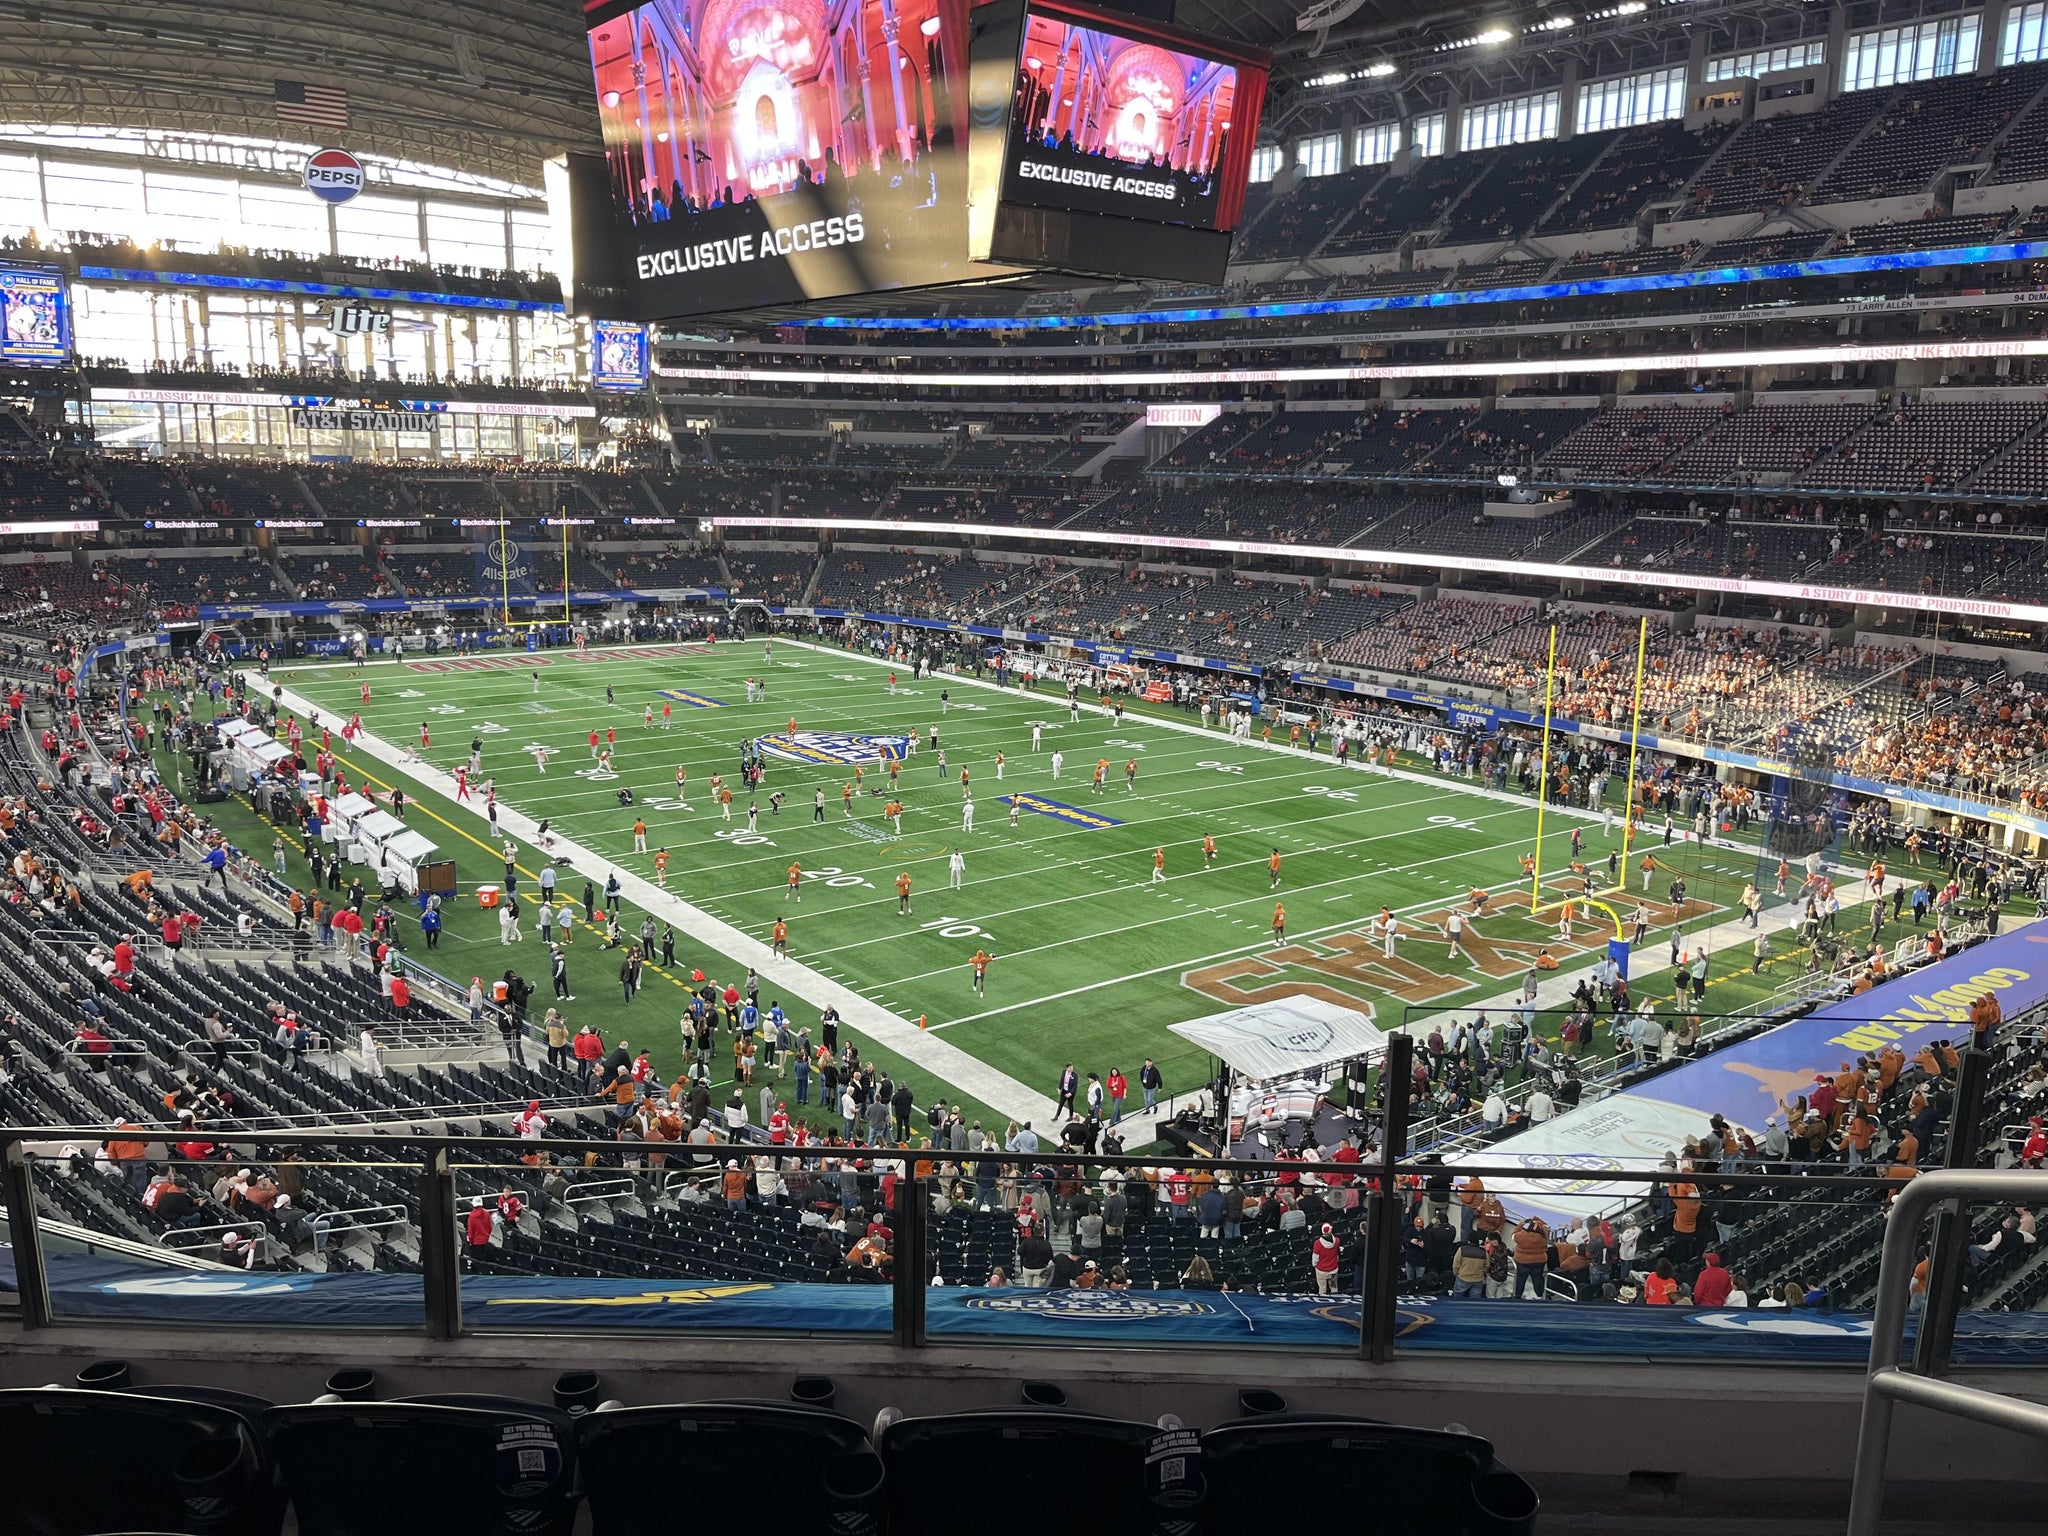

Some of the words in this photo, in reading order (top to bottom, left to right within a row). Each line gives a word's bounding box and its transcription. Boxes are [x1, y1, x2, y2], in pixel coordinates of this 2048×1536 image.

[308, 168, 361, 186] PEPSI
[1018, 161, 1111, 190] EXCLUSIVE
[1114, 179, 1175, 200] ACCESS
[636, 234, 755, 280] EXCLUSIVE
[759, 213, 865, 257] ACCESS
[16, 277, 31, 285] HALL
[40, 278, 56, 286] FAME
[2014, 294, 2025, 302] 94
[1846, 303, 1855, 312] 73
[1858, 303, 1884, 312] LARRY
[1886, 301, 1913, 310] ALLEN
[328, 306, 392, 338] Lite
[1709, 313, 1736, 321] EMMITT
[1738, 311, 1760, 319] SMITH
[1591, 321, 1615, 329] AIKMAN
[1850, 346, 1908, 360] CLASSIC
[1913, 345, 1944, 358] LIKE
[1950, 344, 1970, 356] NO
[1981, 342, 2025, 356] OTHER
[1179, 372, 1214, 382] CLASSIC
[1250, 371, 1278, 381] OTHER
[1349, 370, 1355, 379] A
[1358, 368, 1398, 379] CLASSIC
[128, 390, 137, 400] A
[141, 391, 193, 401] CLASSIC
[197, 392, 222, 403] LIKE
[225, 394, 242, 403] NO
[298, 397, 305, 406] 0
[334, 398, 361, 408] 90:00
[423, 402, 430, 411] 0
[476, 404, 483, 412] A
[486, 405, 527, 414] CLASSIC
[530, 406, 549, 415] LIKE
[552, 407, 565, 415] NO
[295, 410, 345, 429] AT&T
[351, 412, 438, 433] STADIUM
[73, 522, 81, 530] A
[154, 520, 218, 529] Blockchain.com
[264, 519, 324, 528] Blockchain.com
[366, 519, 421, 527] Blockchain.com
[460, 518, 511, 526] Blockchain.com
[631, 517, 675, 525] Blockchain.com
[1169, 538, 1211, 548] PROPORTION
[1245, 544, 1268, 552] STORY
[481, 564, 528, 581] Allstate
[1577, 569, 1585, 578] A
[1585, 569, 1617, 580] STORY
[1619, 572, 1631, 582] OF
[1633, 573, 1673, 585] MYTHIC
[1675, 576, 1744, 591] PROPORTION
[1801, 586, 1810, 597] A
[1813, 587, 1851, 601] STORY
[1855, 591, 1870, 603] OF
[1873, 593, 1922, 608] MYTHIC
[1926, 598, 2011, 616] PROPORTION
[1095, 645, 1126, 654] GOODYEAR
[405, 656, 555, 674] OHIO
[1226, 662, 1252, 672] GOODYEAR
[1300, 675, 1328, 685] GOODYEAR
[1412, 694, 1444, 705] GOODYEAR
[1450, 702, 1495, 716] GOODYEAR
[1455, 712, 1487, 725] COTTON
[1302, 785, 1360, 800] 20
[1426, 815, 1477, 829] 10
[714, 828, 768, 845] 30
[802, 866, 865, 888] 20
[481, 894, 490, 903] G
[919, 916, 982, 938] 10
[1832, 966, 2030, 1052] GOODYEAR
[1288, 1031, 1319, 1047] CFP
[1867, 1092, 1878, 1104] 12
[521, 1122, 531, 1134] 15
[1560, 1110, 1623, 1137] SEMIFINAL
[1582, 1116, 1633, 1139] PLAYOFF
[1173, 1183, 1187, 1197] 15
[503, 1203, 510, 1214] 8
[856, 1238, 868, 1250] 8
[1601, 1248, 1607, 1264] 1
[1176, 1431, 1191, 1439] FOOD
